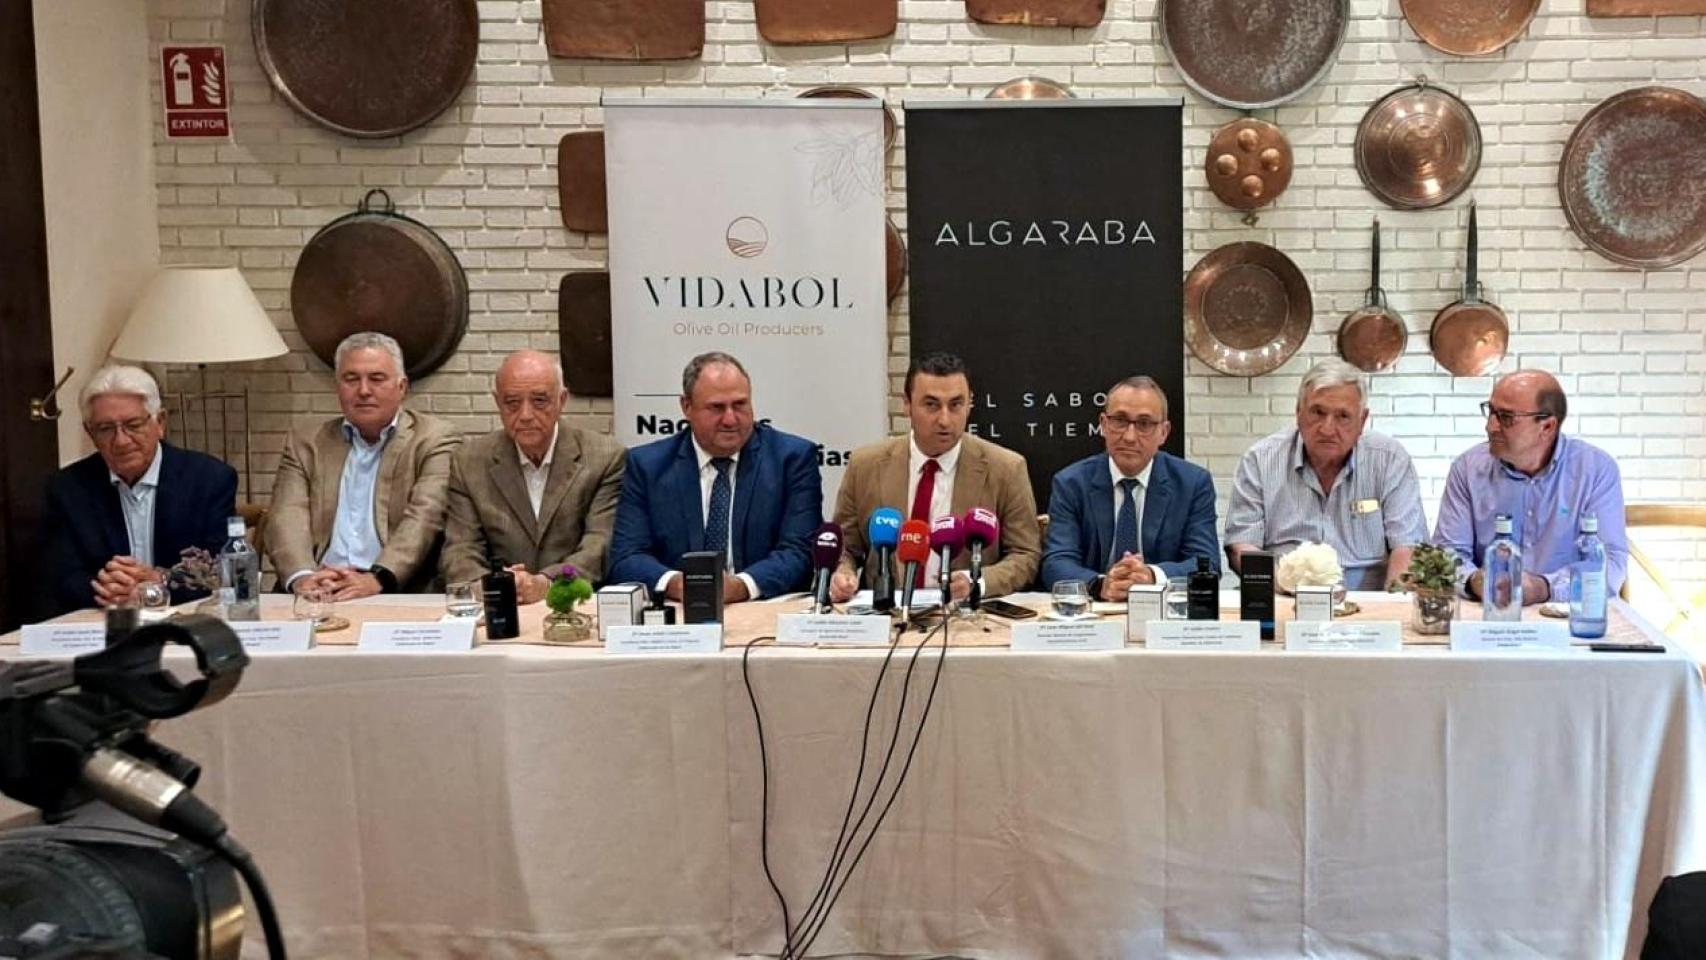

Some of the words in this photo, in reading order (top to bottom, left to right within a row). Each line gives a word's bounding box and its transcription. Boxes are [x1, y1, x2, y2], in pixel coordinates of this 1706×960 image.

[171, 119, 225, 129] EXTINTOR
[934, 219, 1156, 247] ALGARABA
[643, 275, 854, 309] VIDABOL
[672, 321, 713, 336] Olive
[717, 321, 740, 336] Oil
[744, 321, 825, 336] Producers
[1022, 392, 1108, 408] SABO
[967, 422, 1001, 437] EL
[1026, 422, 1105, 437] TIEM
[875, 516, 899, 528] tve
[901, 532, 922, 544] rne
